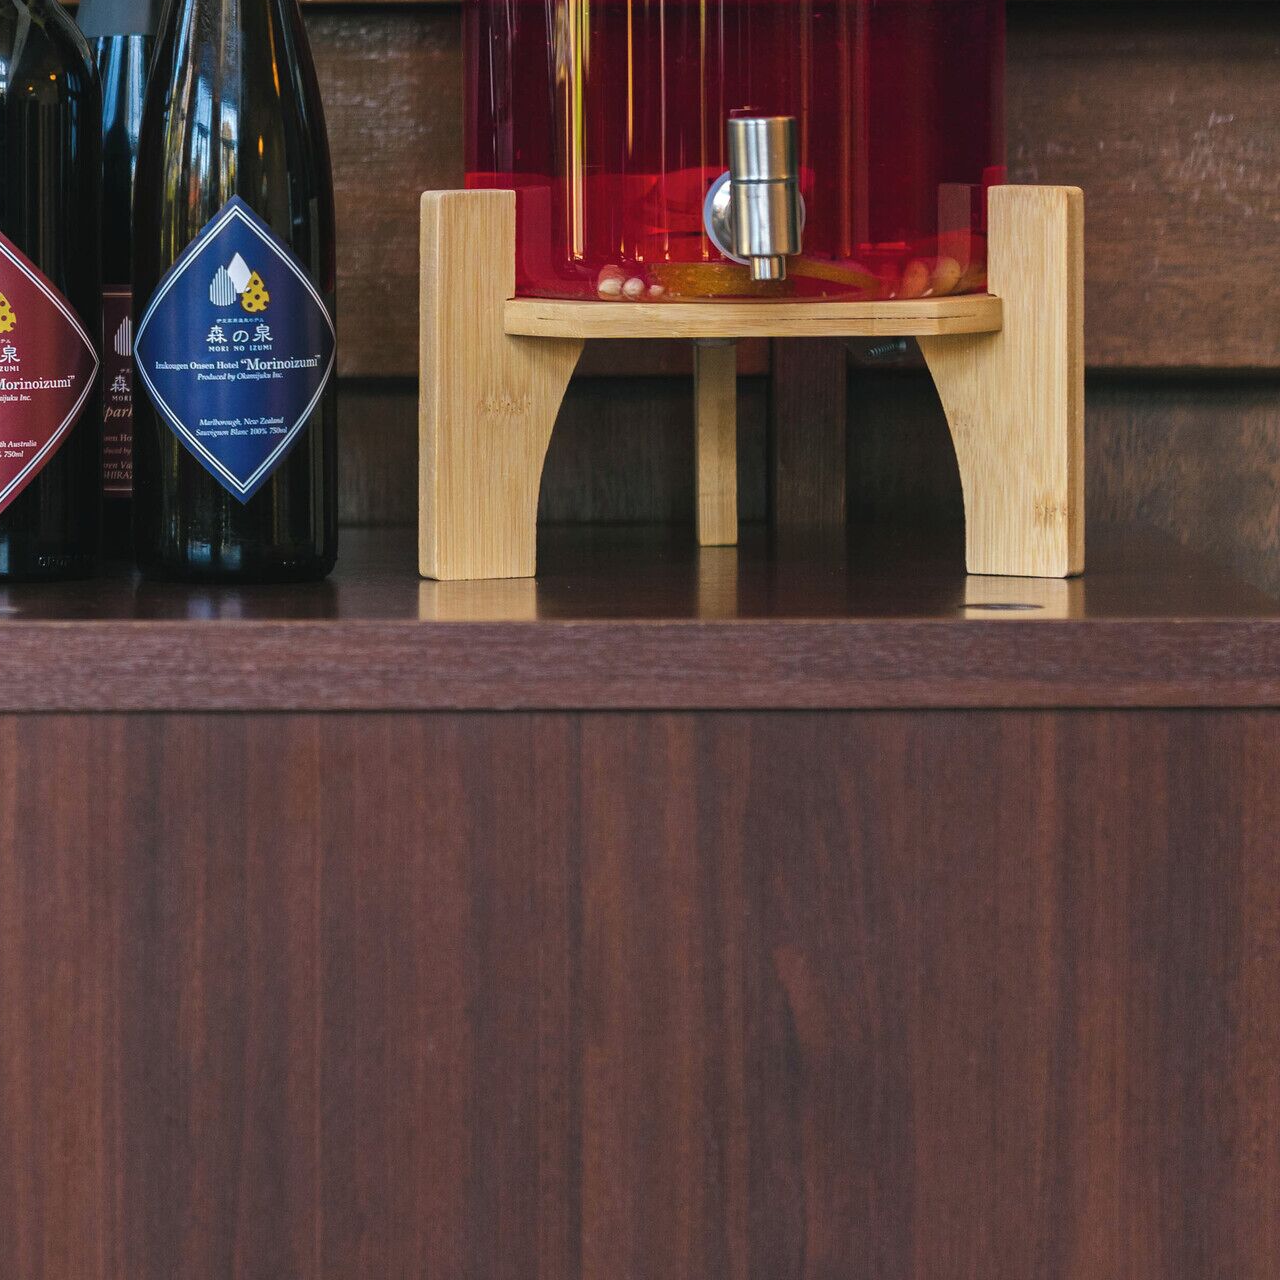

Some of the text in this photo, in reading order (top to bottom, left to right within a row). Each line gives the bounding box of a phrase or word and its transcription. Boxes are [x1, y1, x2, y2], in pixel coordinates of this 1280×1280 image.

[206, 323, 273, 343] 森の泉
[189, 362, 215, 370] Onsen
[216, 361, 239, 369] Hotel
[197, 372, 226, 381] Produced
[227, 373, 236, 382] by
[272, 371, 284, 379] Inc.
[259, 416, 284, 425] Zealand
[195, 427, 288, 438] Sauvignon Blanc 100% 750ml
[7, 440, 37, 448] Australia
[3, 450, 24, 458] 750ml
